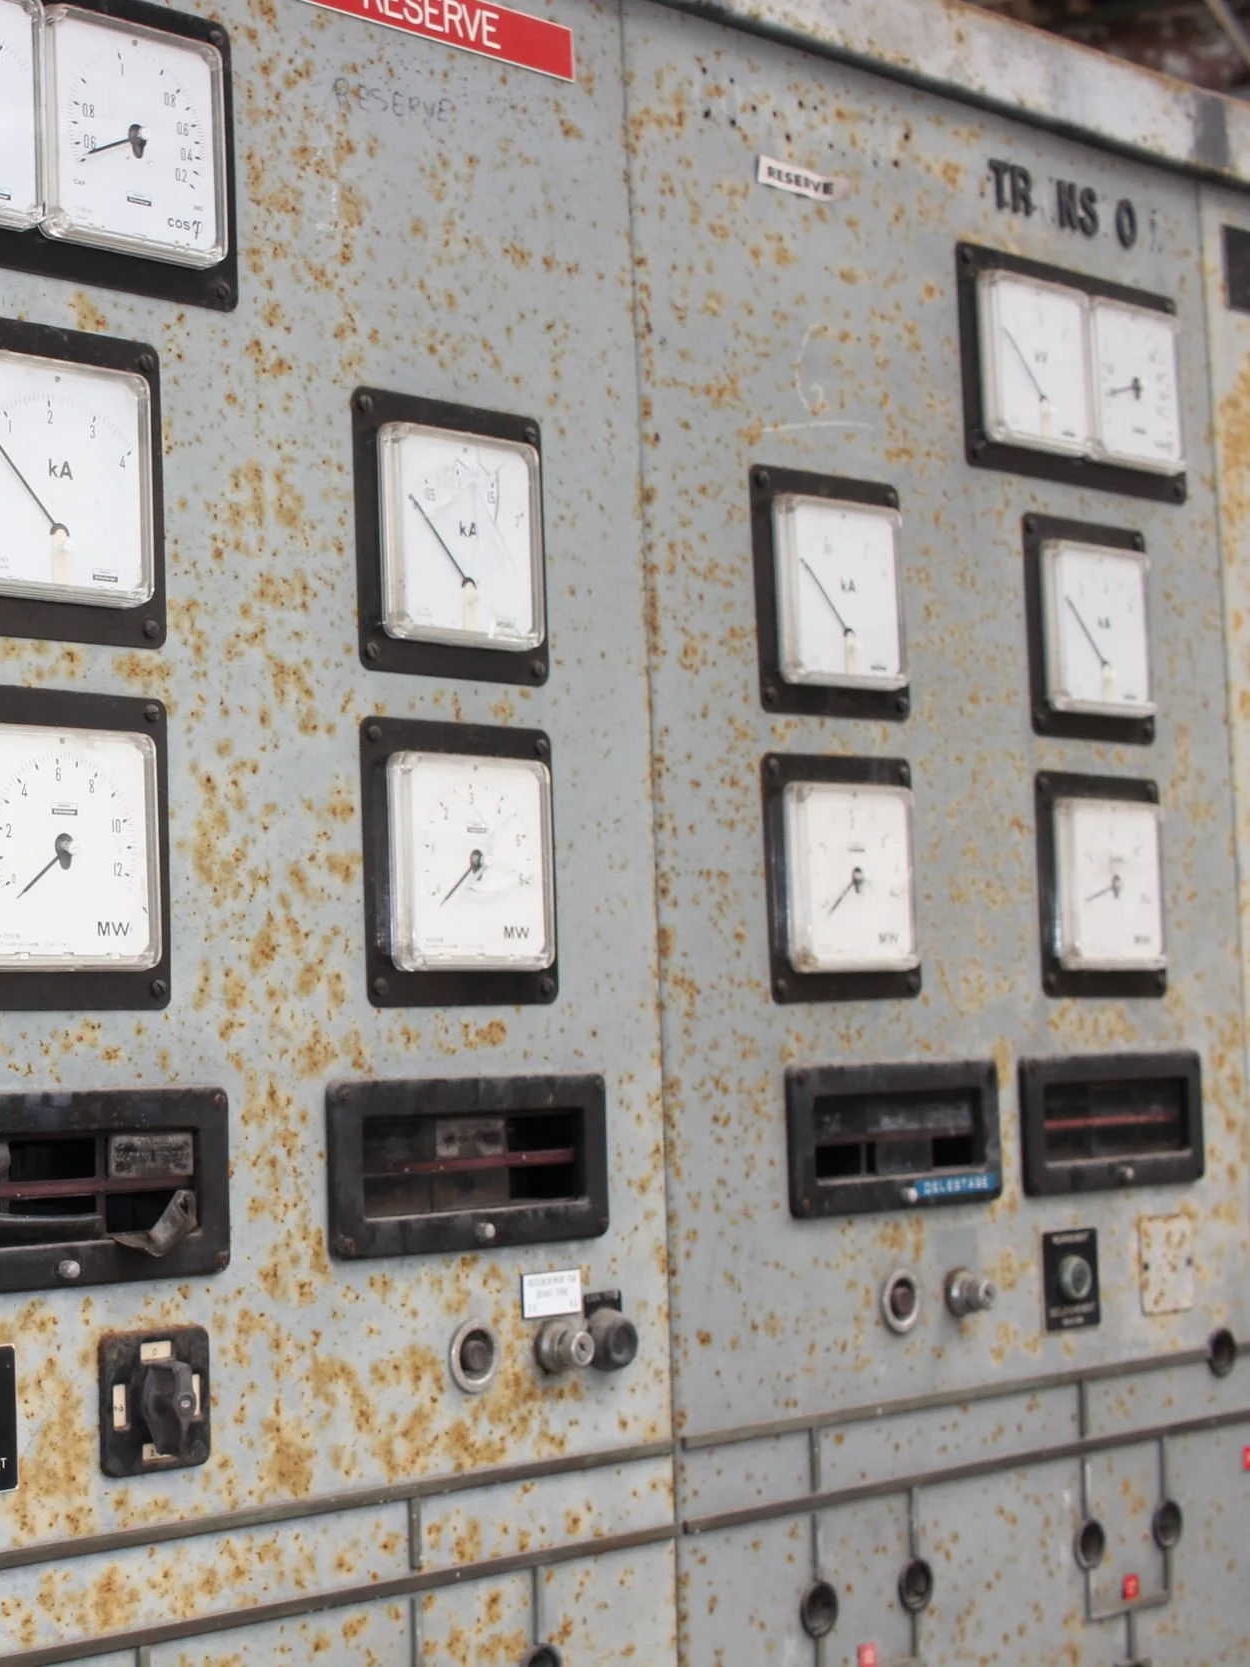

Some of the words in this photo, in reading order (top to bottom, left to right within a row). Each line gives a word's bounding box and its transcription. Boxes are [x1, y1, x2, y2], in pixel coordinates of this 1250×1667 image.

[333, 76, 452, 123] RESERVE
[764, 164, 835, 197] RESERVE
[47, 409, 54, 425] 2
[89, 424, 96, 439] 3
[48, 458, 74, 481] kA
[119, 455, 127, 469] 4
[458, 520, 478, 538] kA
[55, 767, 62, 782] 6
[20, 783, 28, 799] 4
[88, 778, 95, 794] 8
[5, 823, 12, 839] 2
[111, 819, 121, 835] 10
[113, 862, 123, 878] 12
[96, 920, 131, 938] MW
[503, 925, 531, 940] MW
